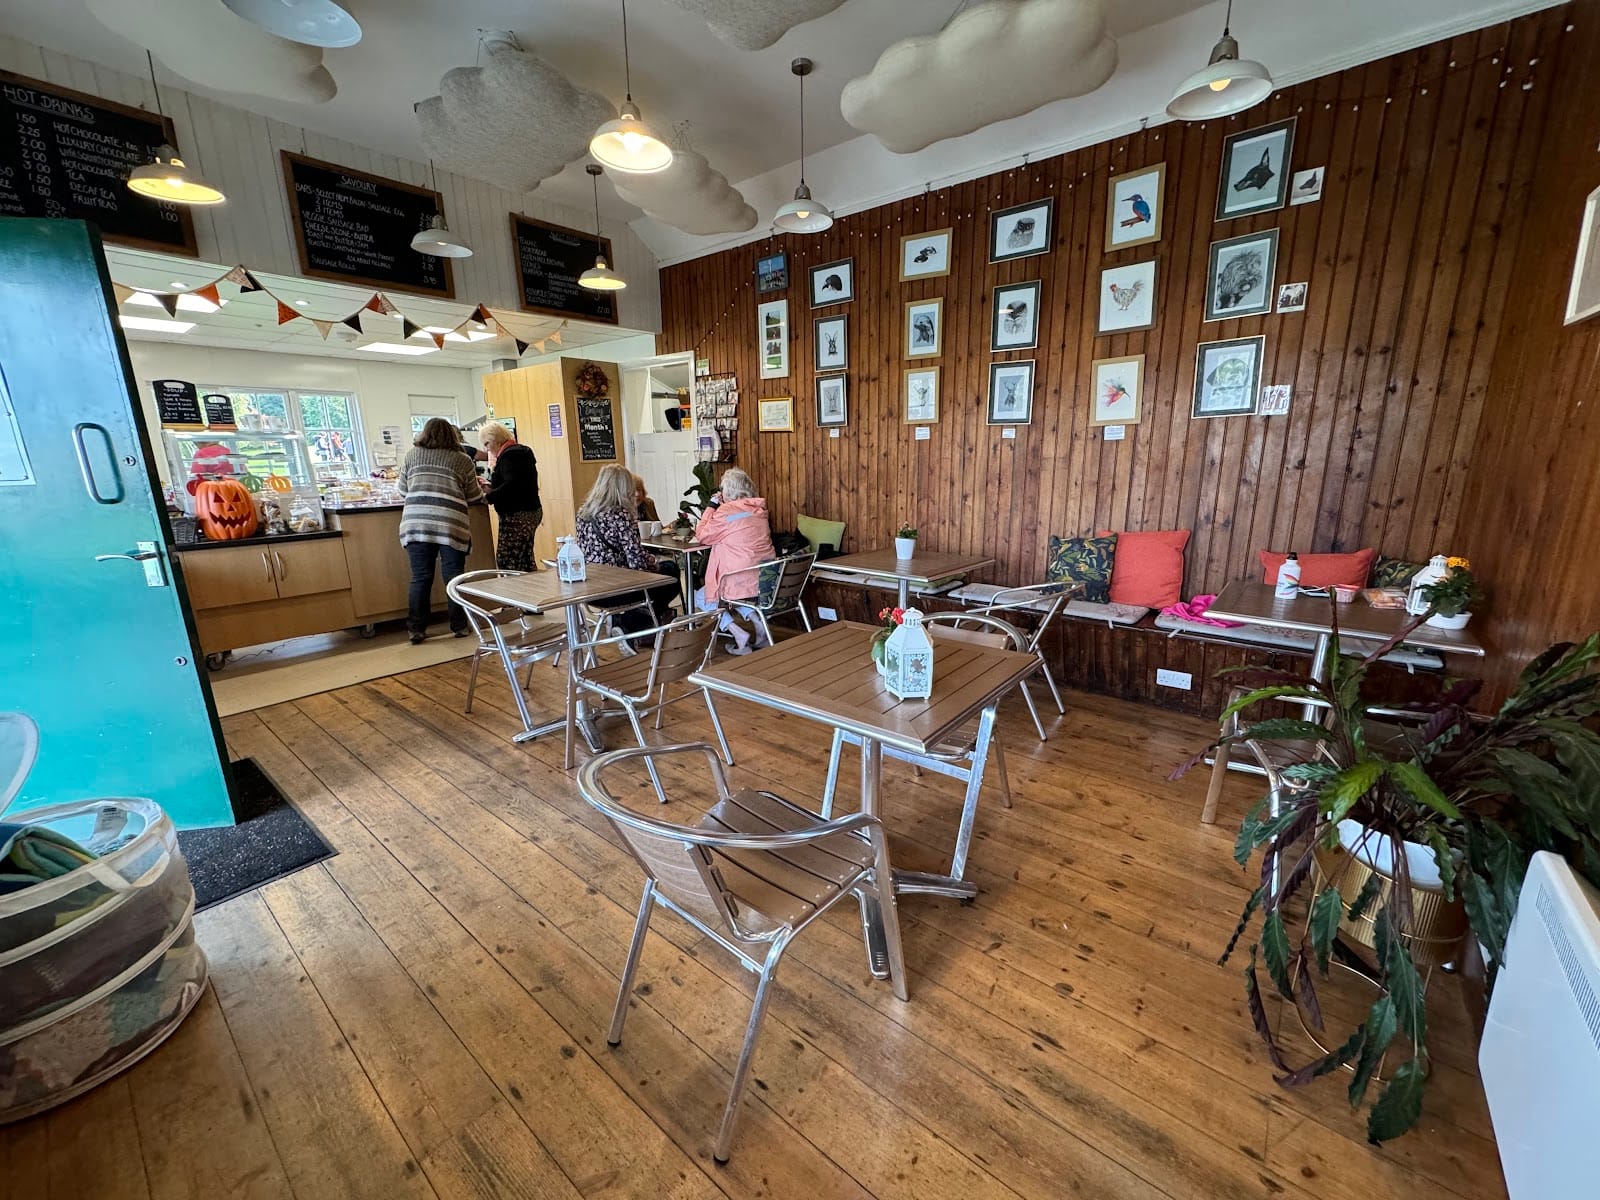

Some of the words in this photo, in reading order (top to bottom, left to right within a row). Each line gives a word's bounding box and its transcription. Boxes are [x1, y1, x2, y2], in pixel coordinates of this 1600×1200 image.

[2, 85, 37, 104] HOT
[40, 95, 95, 120] DRINKS
[341, 175, 377, 193] SAVOURY
